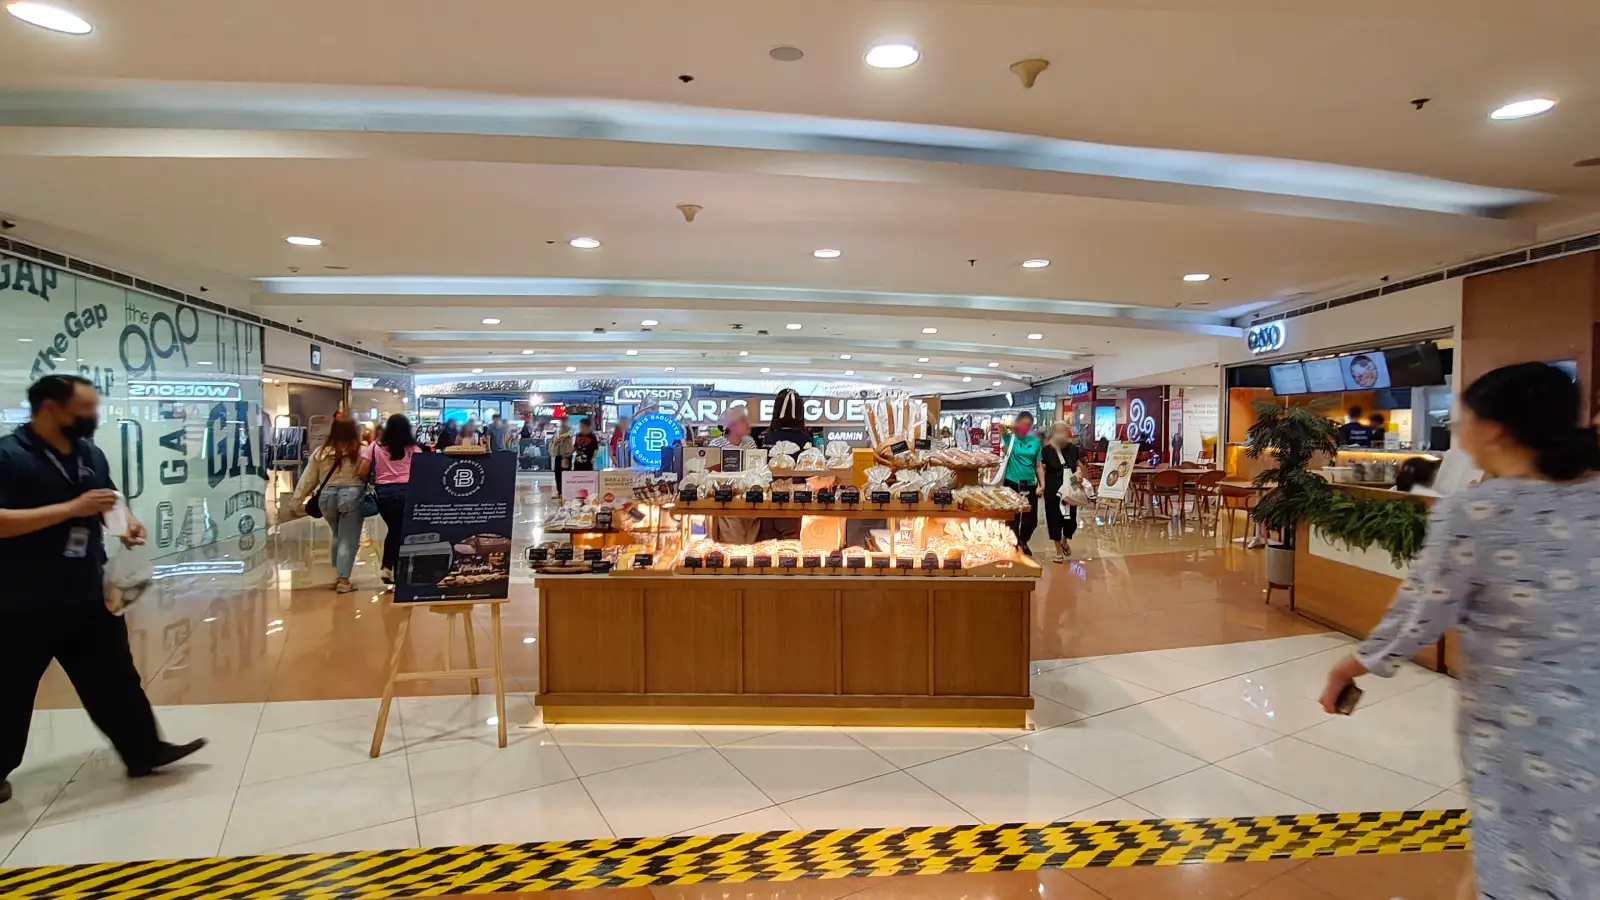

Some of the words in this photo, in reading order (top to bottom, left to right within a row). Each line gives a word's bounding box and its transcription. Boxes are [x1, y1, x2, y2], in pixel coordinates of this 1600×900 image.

[64, 303, 108, 338] Gap
[126, 303, 149, 324] the
[625, 389, 683, 400] watsons
[633, 417, 649, 434] PARIS
[650, 414, 680, 436] BAGUETTE
[827, 431, 864, 441] GARMIN
[635, 449, 661, 465] BOULAN
